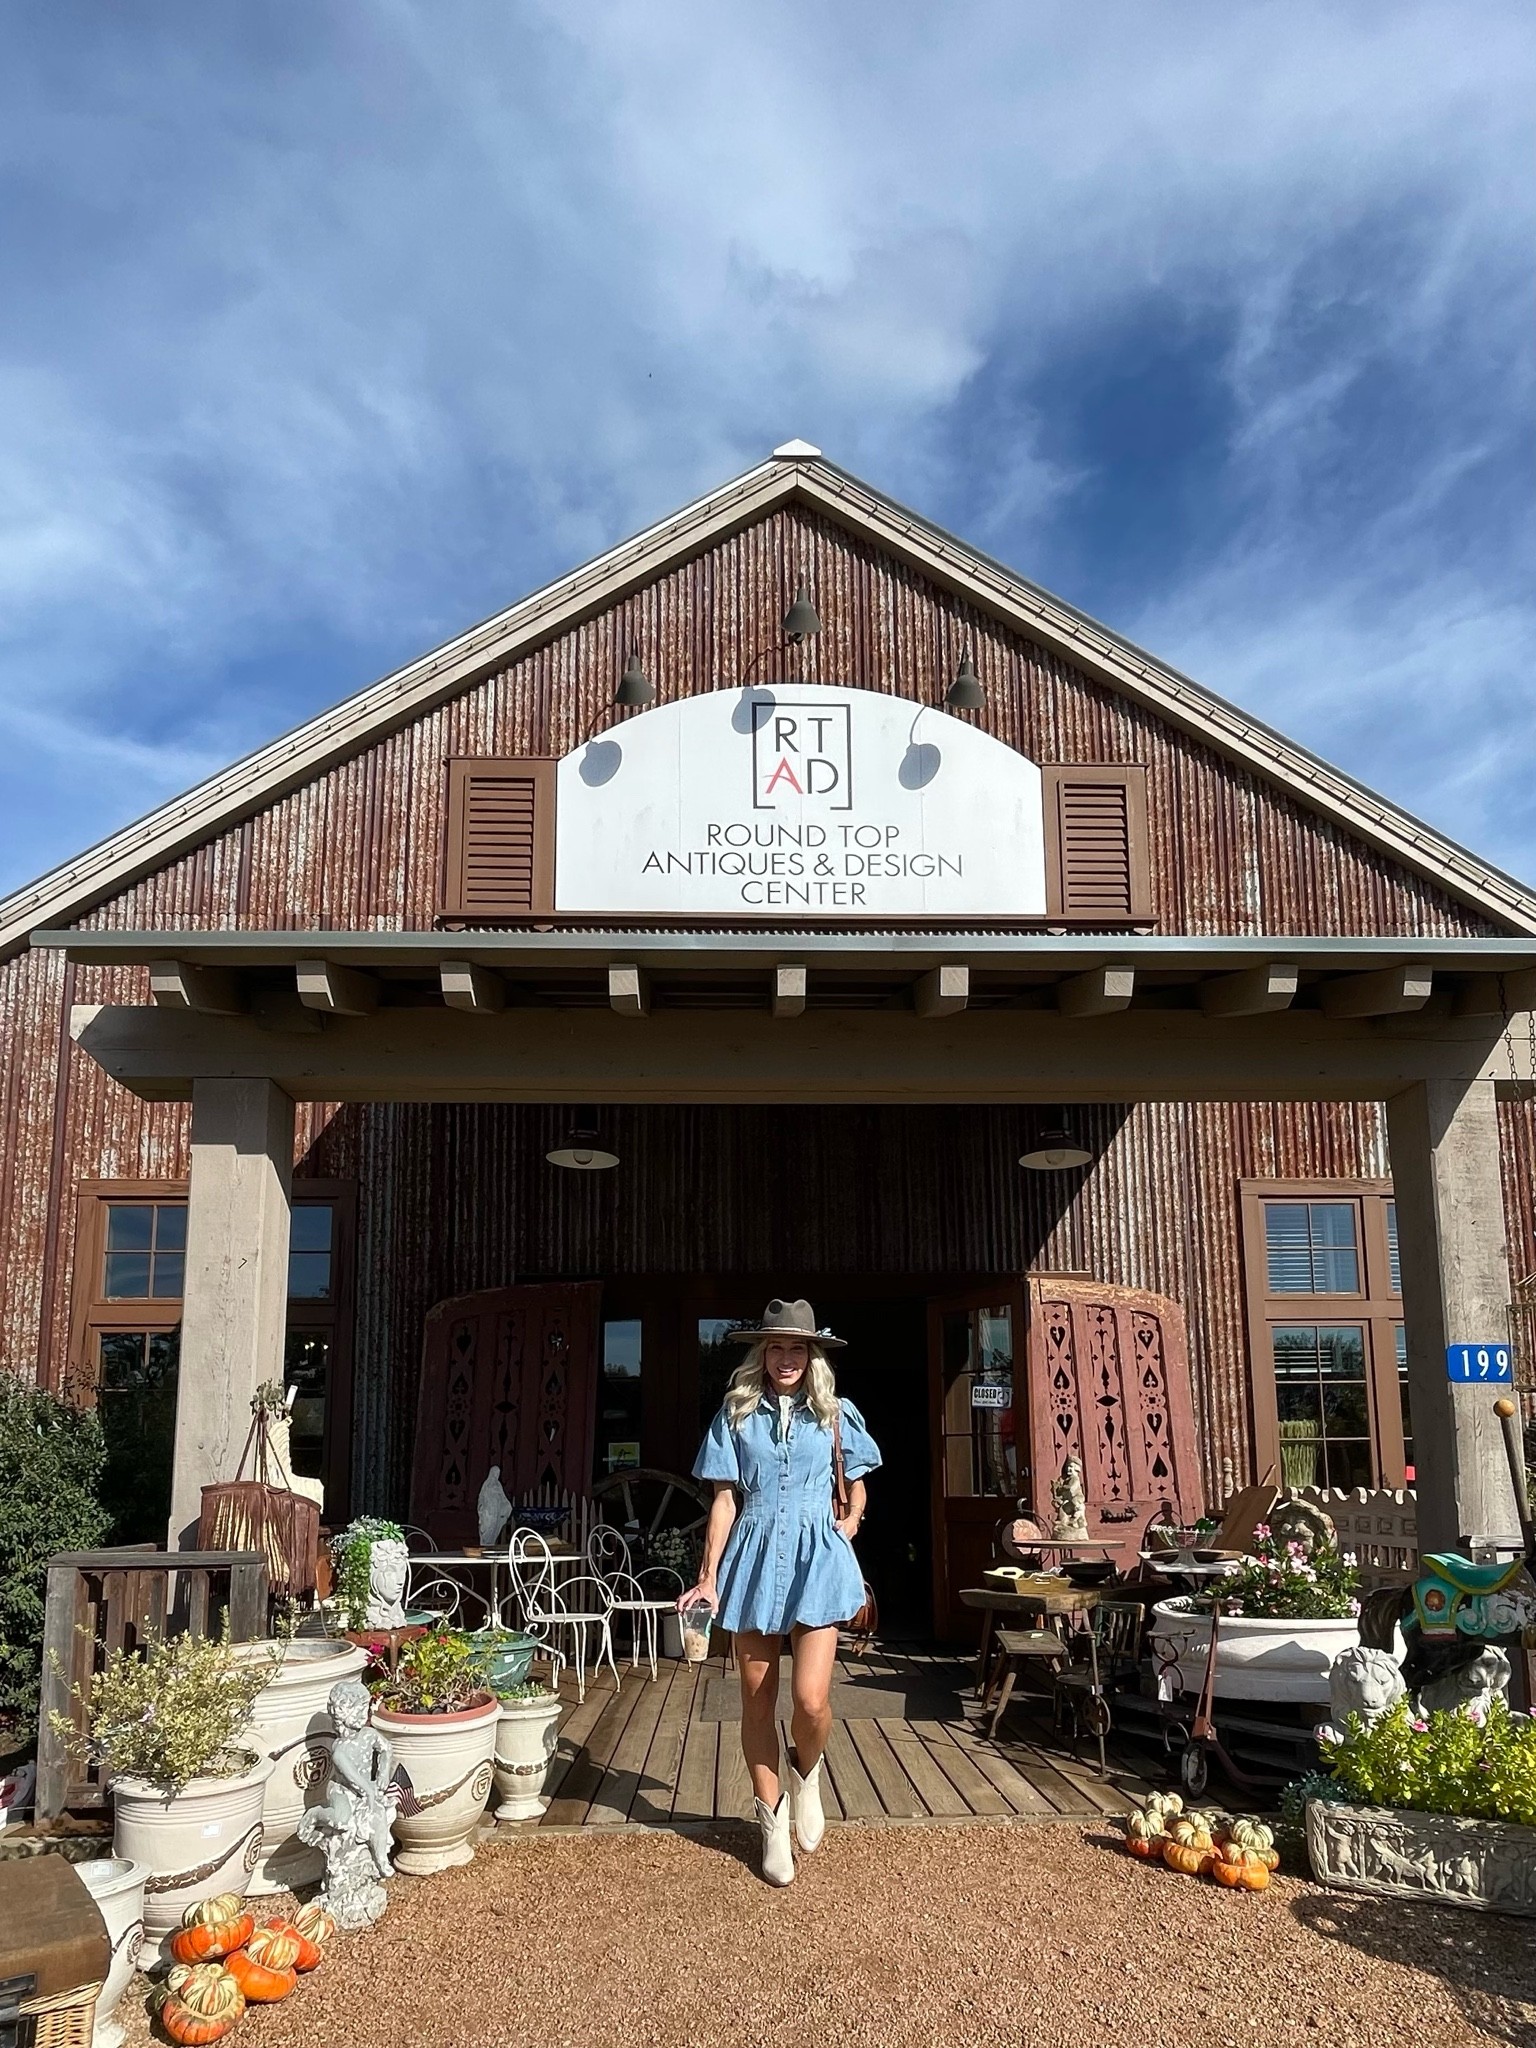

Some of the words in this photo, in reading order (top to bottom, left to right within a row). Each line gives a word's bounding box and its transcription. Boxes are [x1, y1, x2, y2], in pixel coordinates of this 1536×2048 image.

[775, 716, 833, 754] RT
[763, 757, 839, 795] AD
[707, 824, 827, 849] ROUND
[838, 825, 900, 849] TOP
[642, 851, 804, 876] ANTIQUES
[813, 853, 836, 877] &
[845, 854, 963, 878] DESIGN
[741, 881, 867, 906] CENTER
[1461, 1349, 1508, 1377] 199
[974, 1388, 997, 1399] CLOSED
